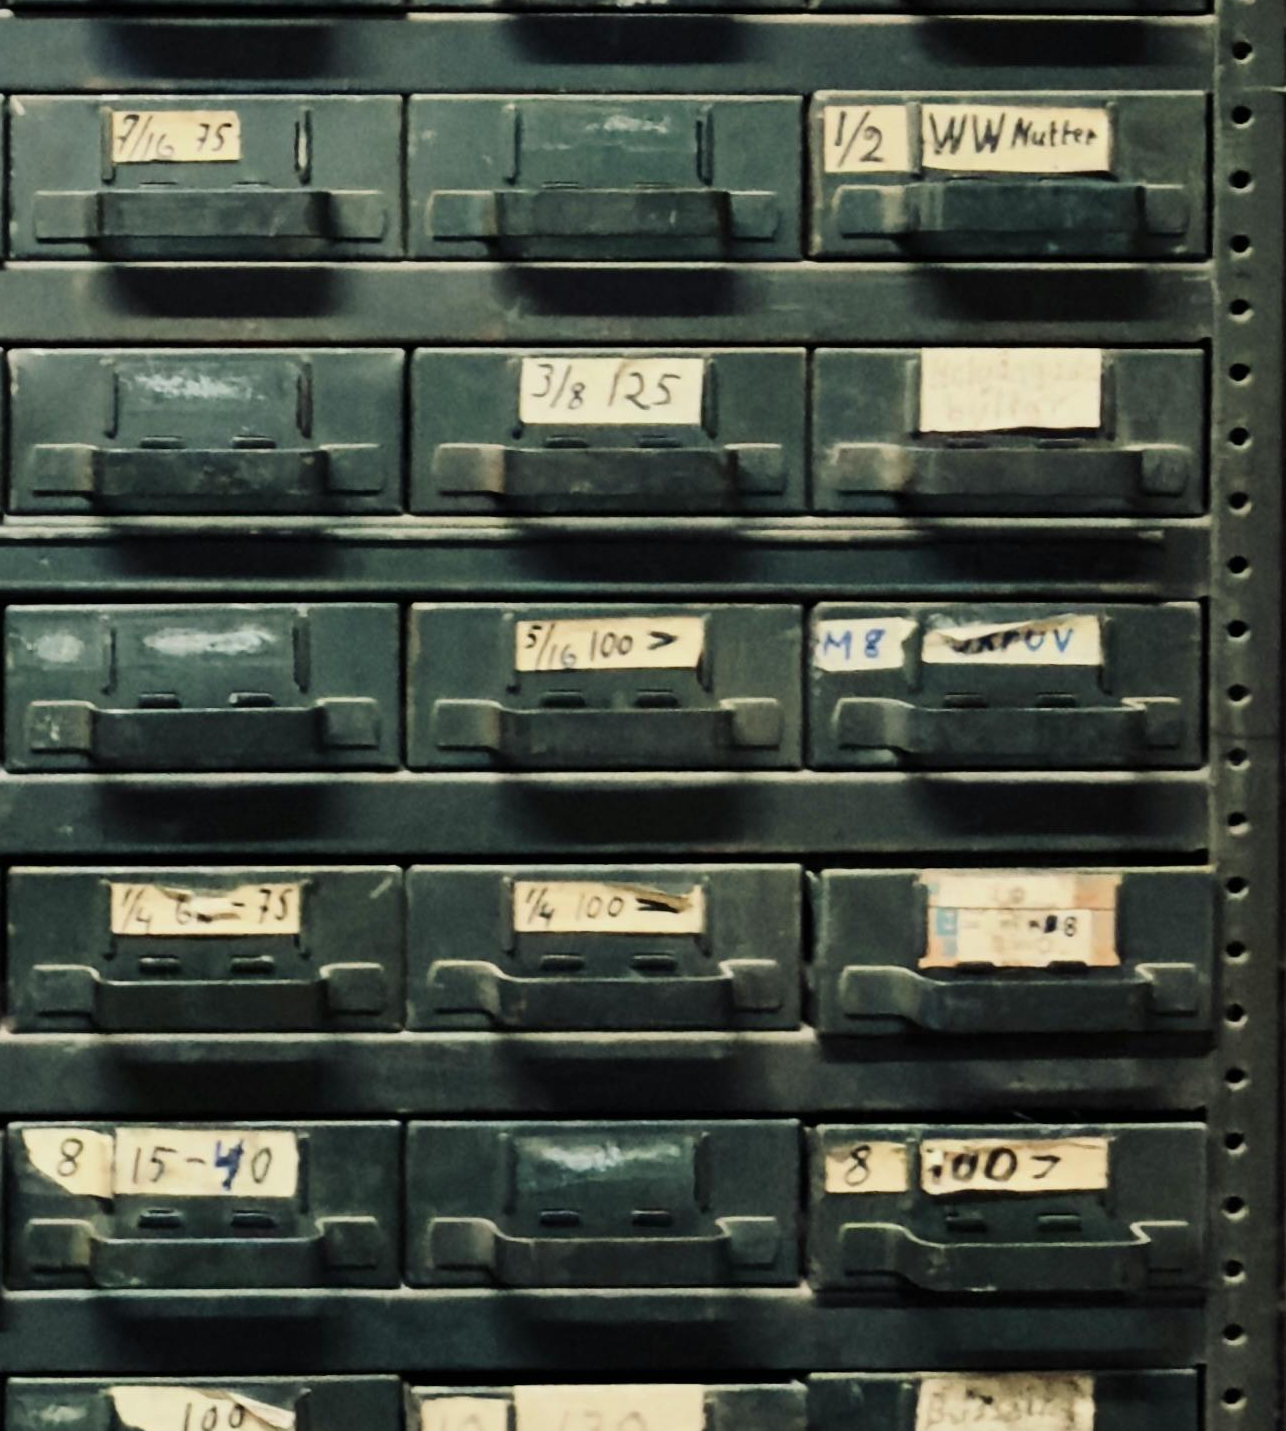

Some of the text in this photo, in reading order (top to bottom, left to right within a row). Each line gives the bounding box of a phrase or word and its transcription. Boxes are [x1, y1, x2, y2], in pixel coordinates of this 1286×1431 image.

[117, 116, 232, 158] 7/16 75
[833, 113, 883, 164] 1/2
[531, 358, 680, 409] 3/8 125
[524, 624, 576, 671] 5/16
[590, 628, 634, 657] 100
[122, 886, 153, 934] 1/4
[525, 887, 624, 928] 1/4 100
[58, 1138, 80, 1175] 8
[848, 1148, 870, 1186] 8
